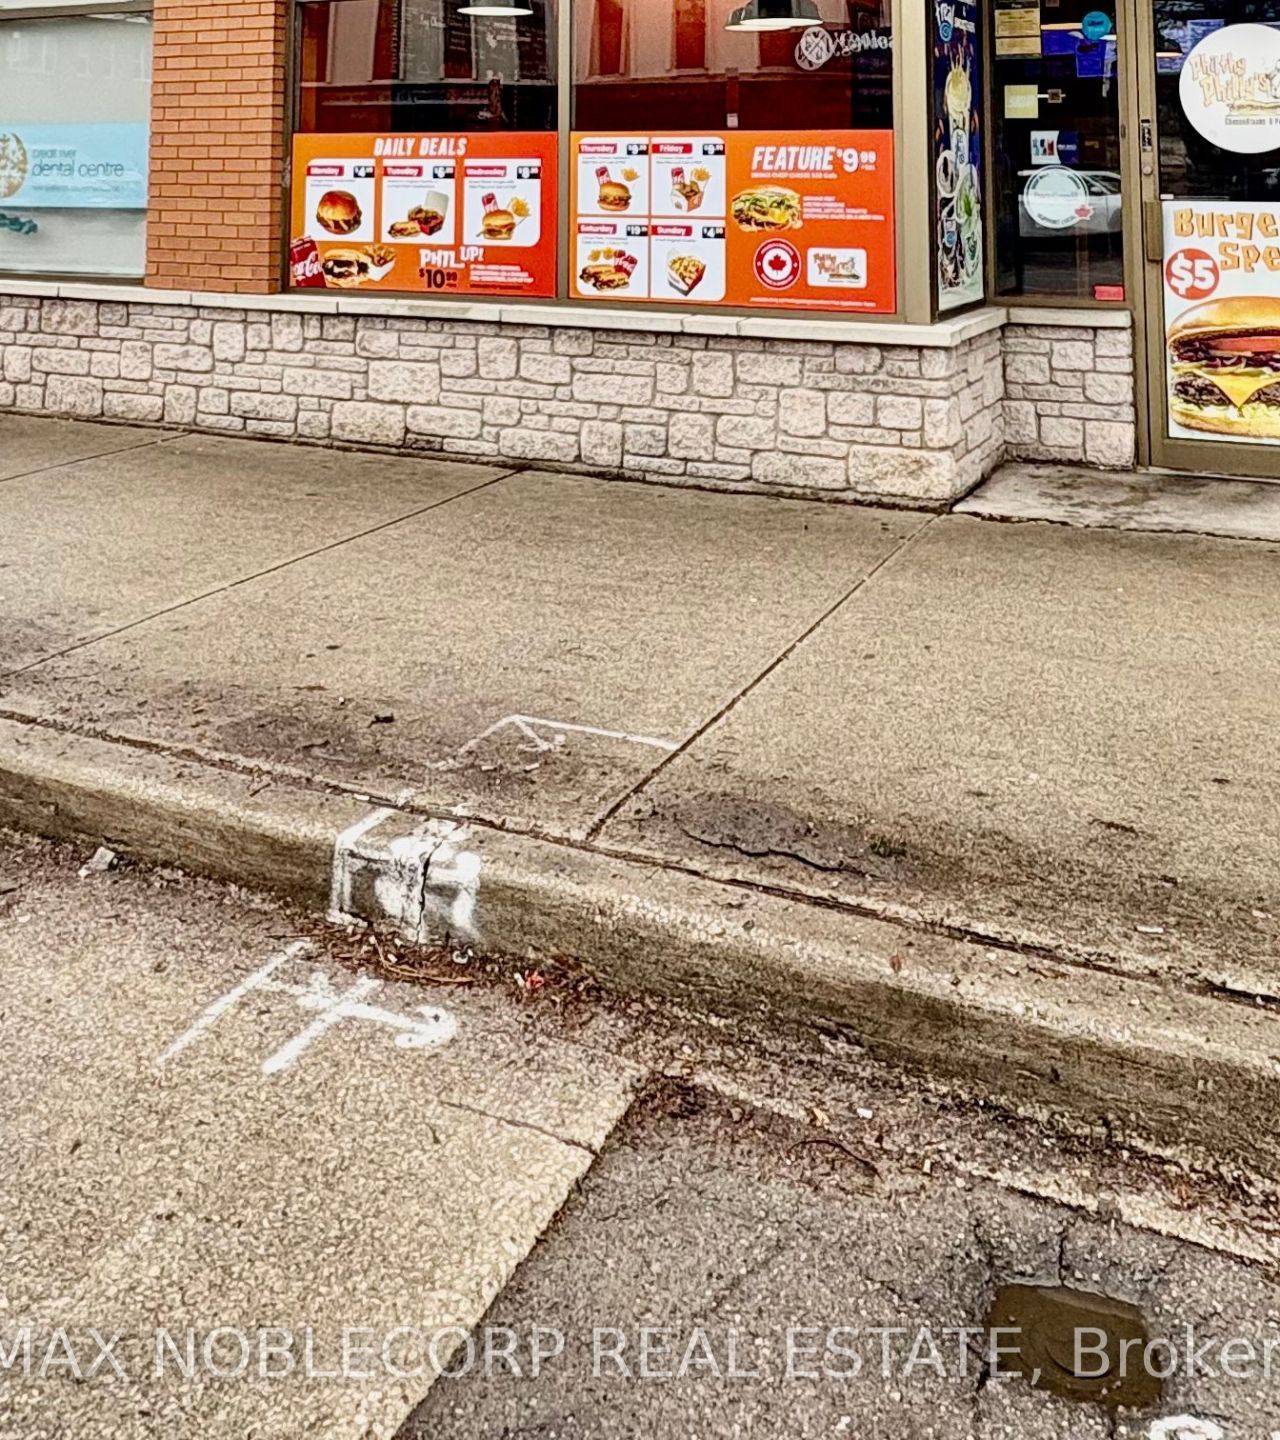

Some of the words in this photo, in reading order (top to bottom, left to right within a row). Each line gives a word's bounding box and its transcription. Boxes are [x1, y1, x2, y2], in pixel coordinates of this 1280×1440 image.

[374, 138, 415, 156] DAILY
[419, 138, 468, 156] DEALS
[752, 146, 836, 171] FEATURE
[31, 160, 75, 177] dental
[78, 163, 125, 177] centre
[460, 246, 485, 262] UP!
[1170, 252, 1215, 295] $5
